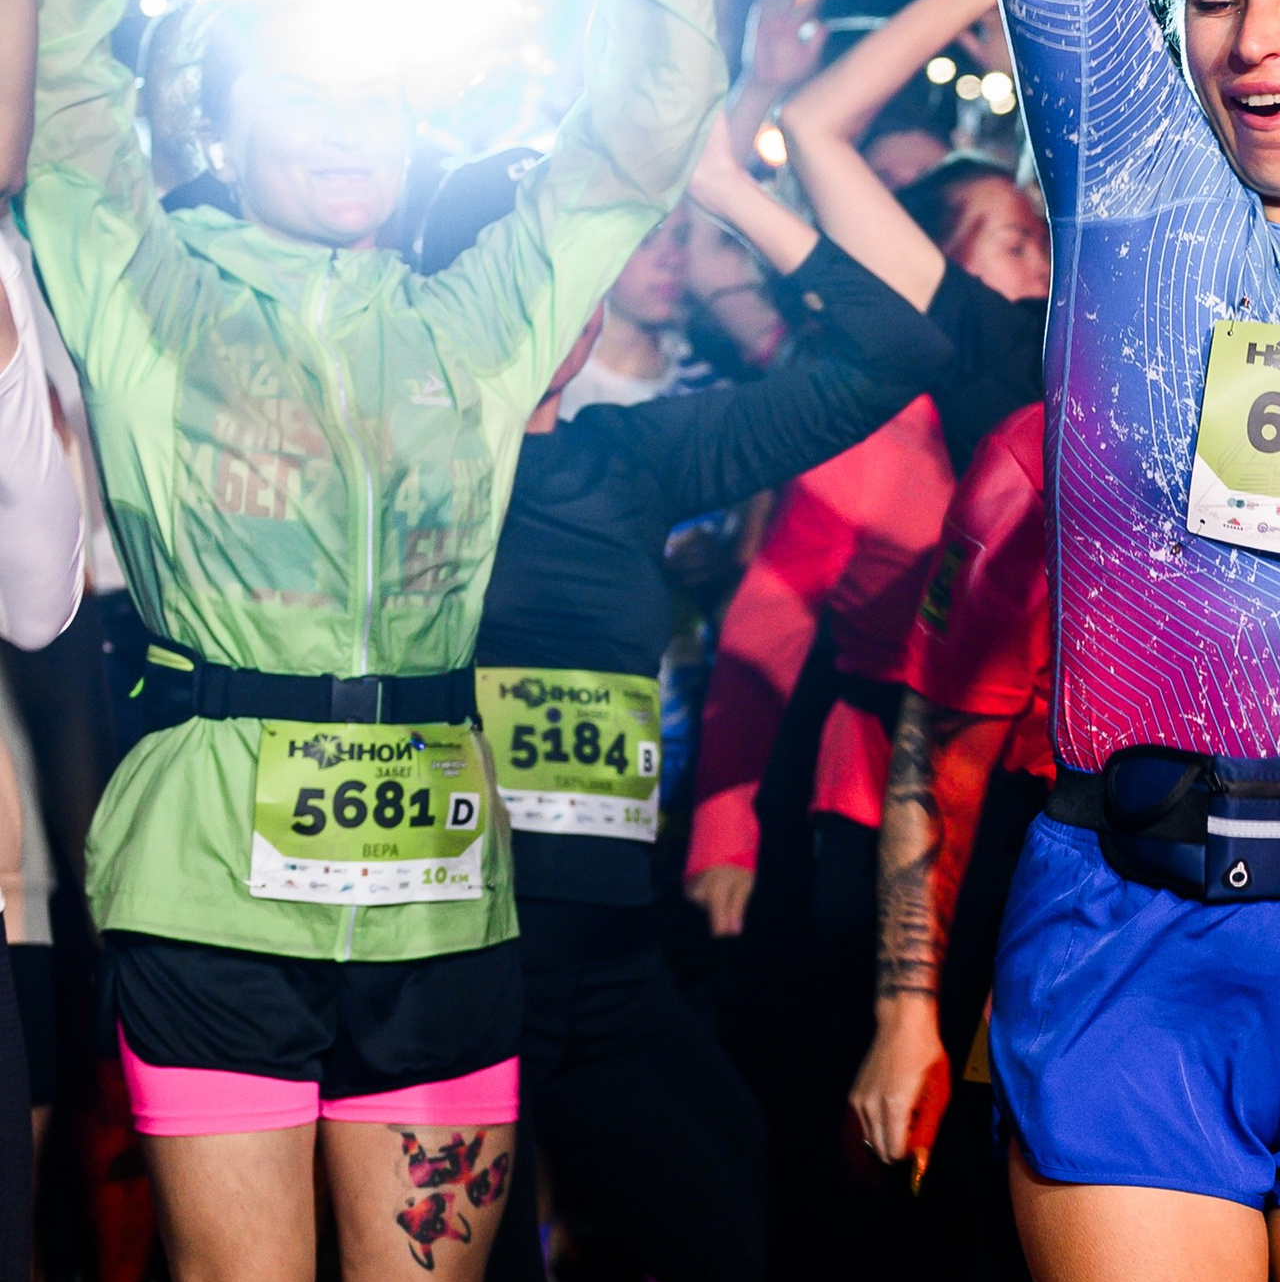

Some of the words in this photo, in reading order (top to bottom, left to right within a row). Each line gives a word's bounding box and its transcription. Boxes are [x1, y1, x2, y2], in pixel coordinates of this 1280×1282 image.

[288, 733, 413, 769] НОЧНОЙ
[510, 721, 629, 776] 5184
[291, 780, 435, 836] 5681
[451, 799, 474, 826] D
[363, 843, 399, 858] ВЕРА
[422, 867, 448, 885] 10
